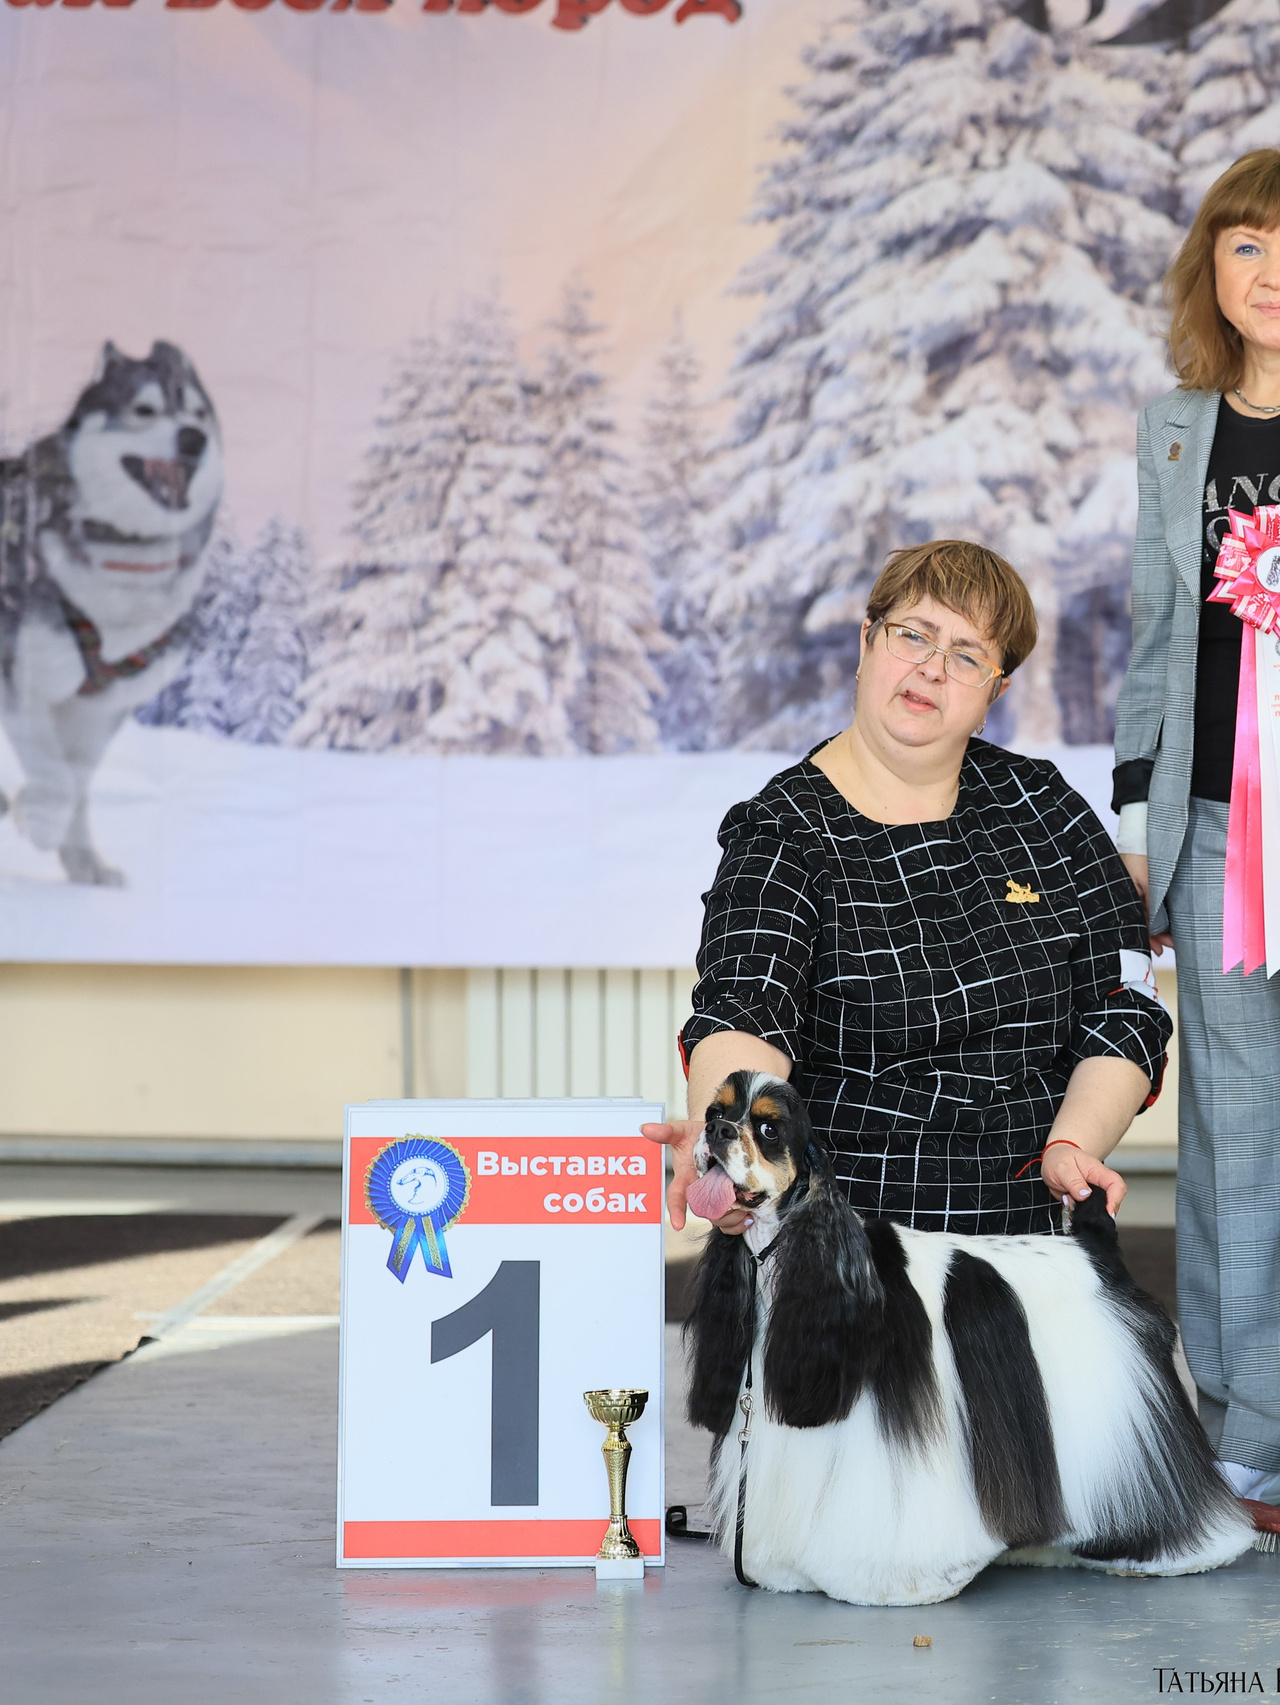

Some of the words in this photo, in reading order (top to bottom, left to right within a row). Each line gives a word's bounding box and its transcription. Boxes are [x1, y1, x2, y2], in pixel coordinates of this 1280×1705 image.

[476, 1151, 647, 1177] Выставка
[543, 1187, 647, 1214] собак
[431, 1260, 540, 1506] 1
